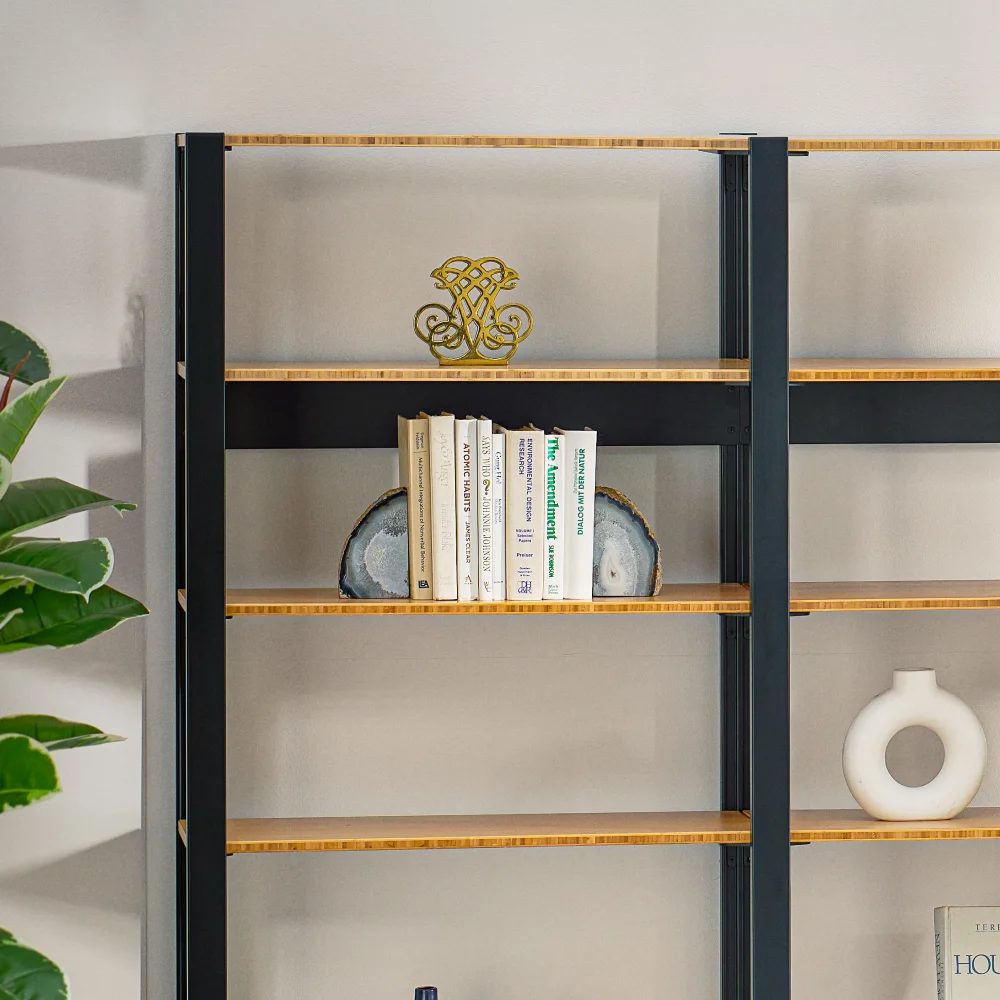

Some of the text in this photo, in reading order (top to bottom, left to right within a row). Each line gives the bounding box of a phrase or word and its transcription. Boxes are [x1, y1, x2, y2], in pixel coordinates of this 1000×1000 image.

[482, 436, 490, 455] SAYS
[482, 457, 490, 477] WHO
[578, 448, 586, 475] NATUR
[547, 436, 559, 540] The Amendment
[483, 497, 491, 571] JOHNNIE JOHNSON
